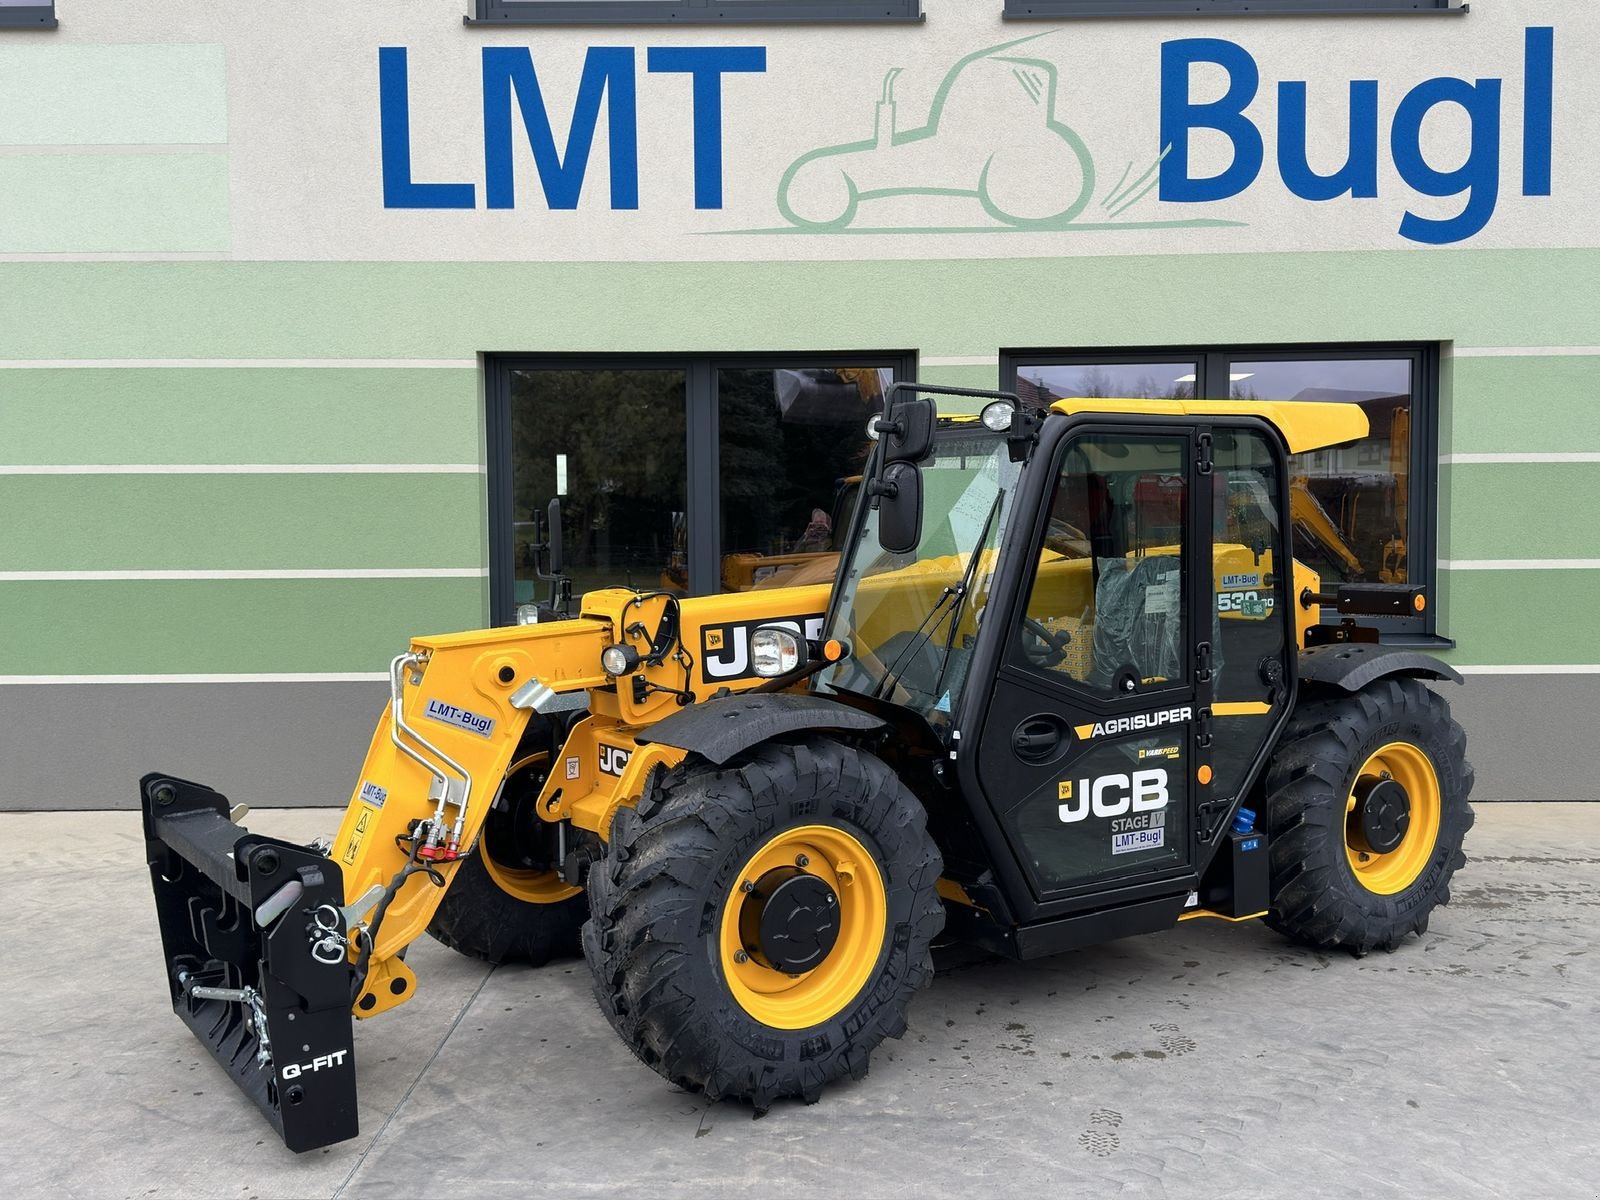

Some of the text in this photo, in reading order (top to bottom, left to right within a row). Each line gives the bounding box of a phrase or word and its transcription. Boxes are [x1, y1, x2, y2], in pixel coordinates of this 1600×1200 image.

[378, 26, 1554, 245] LMT Bugl
[1223, 574, 1259, 585] LMT-Bugl
[429, 700, 492, 731] LMT-Bugl
[1091, 706, 1192, 738] AGRISUPER
[600, 747, 633, 776] JC
[1058, 768, 1169, 823] JCB
[1111, 814, 1149, 832] STAGE
[1115, 829, 1161, 847] LMT-Bugl
[842, 947, 906, 1040] MICHELIN
[282, 1049, 348, 1080] Q-FIT
